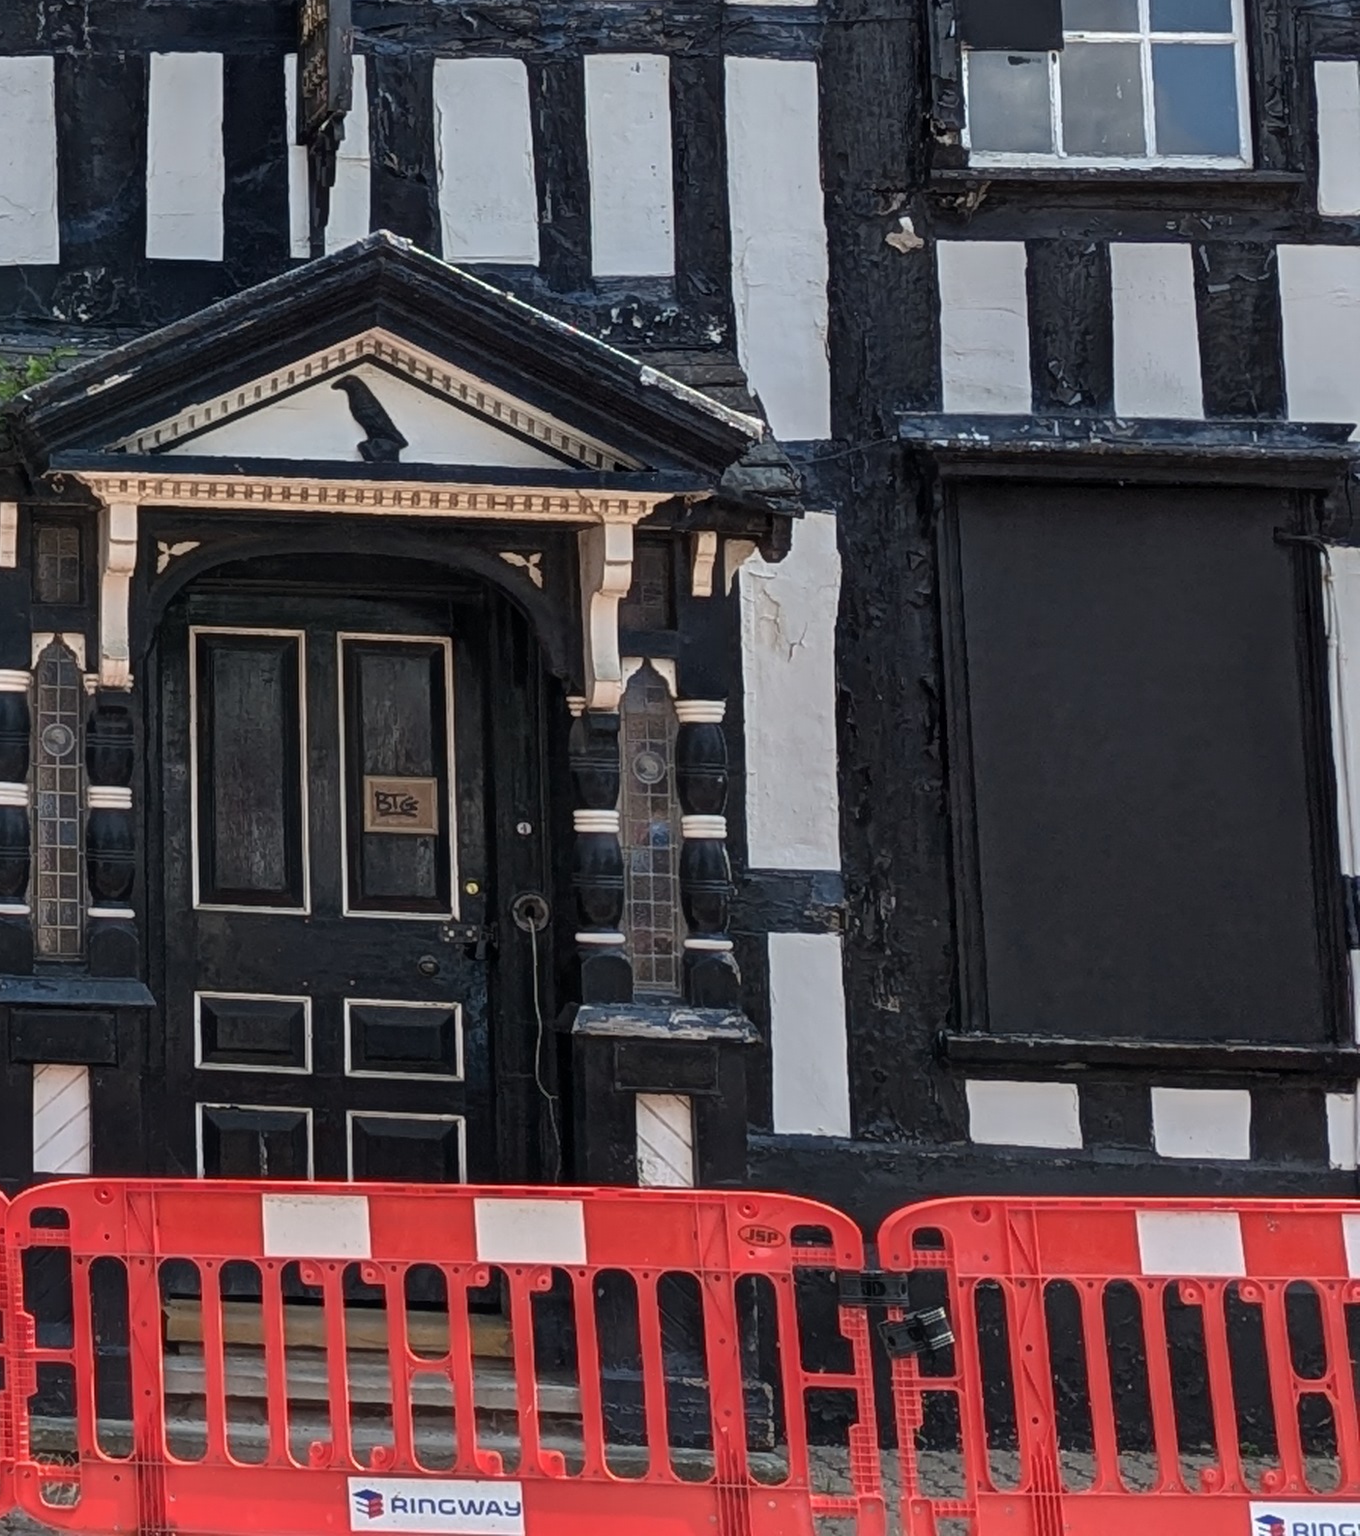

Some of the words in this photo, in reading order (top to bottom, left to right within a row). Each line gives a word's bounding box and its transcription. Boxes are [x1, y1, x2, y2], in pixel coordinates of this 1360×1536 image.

[745, 1228, 778, 1243] JSP
[390, 1498, 521, 1517] RINGWAY
[1292, 1522, 1360, 1536] RING
